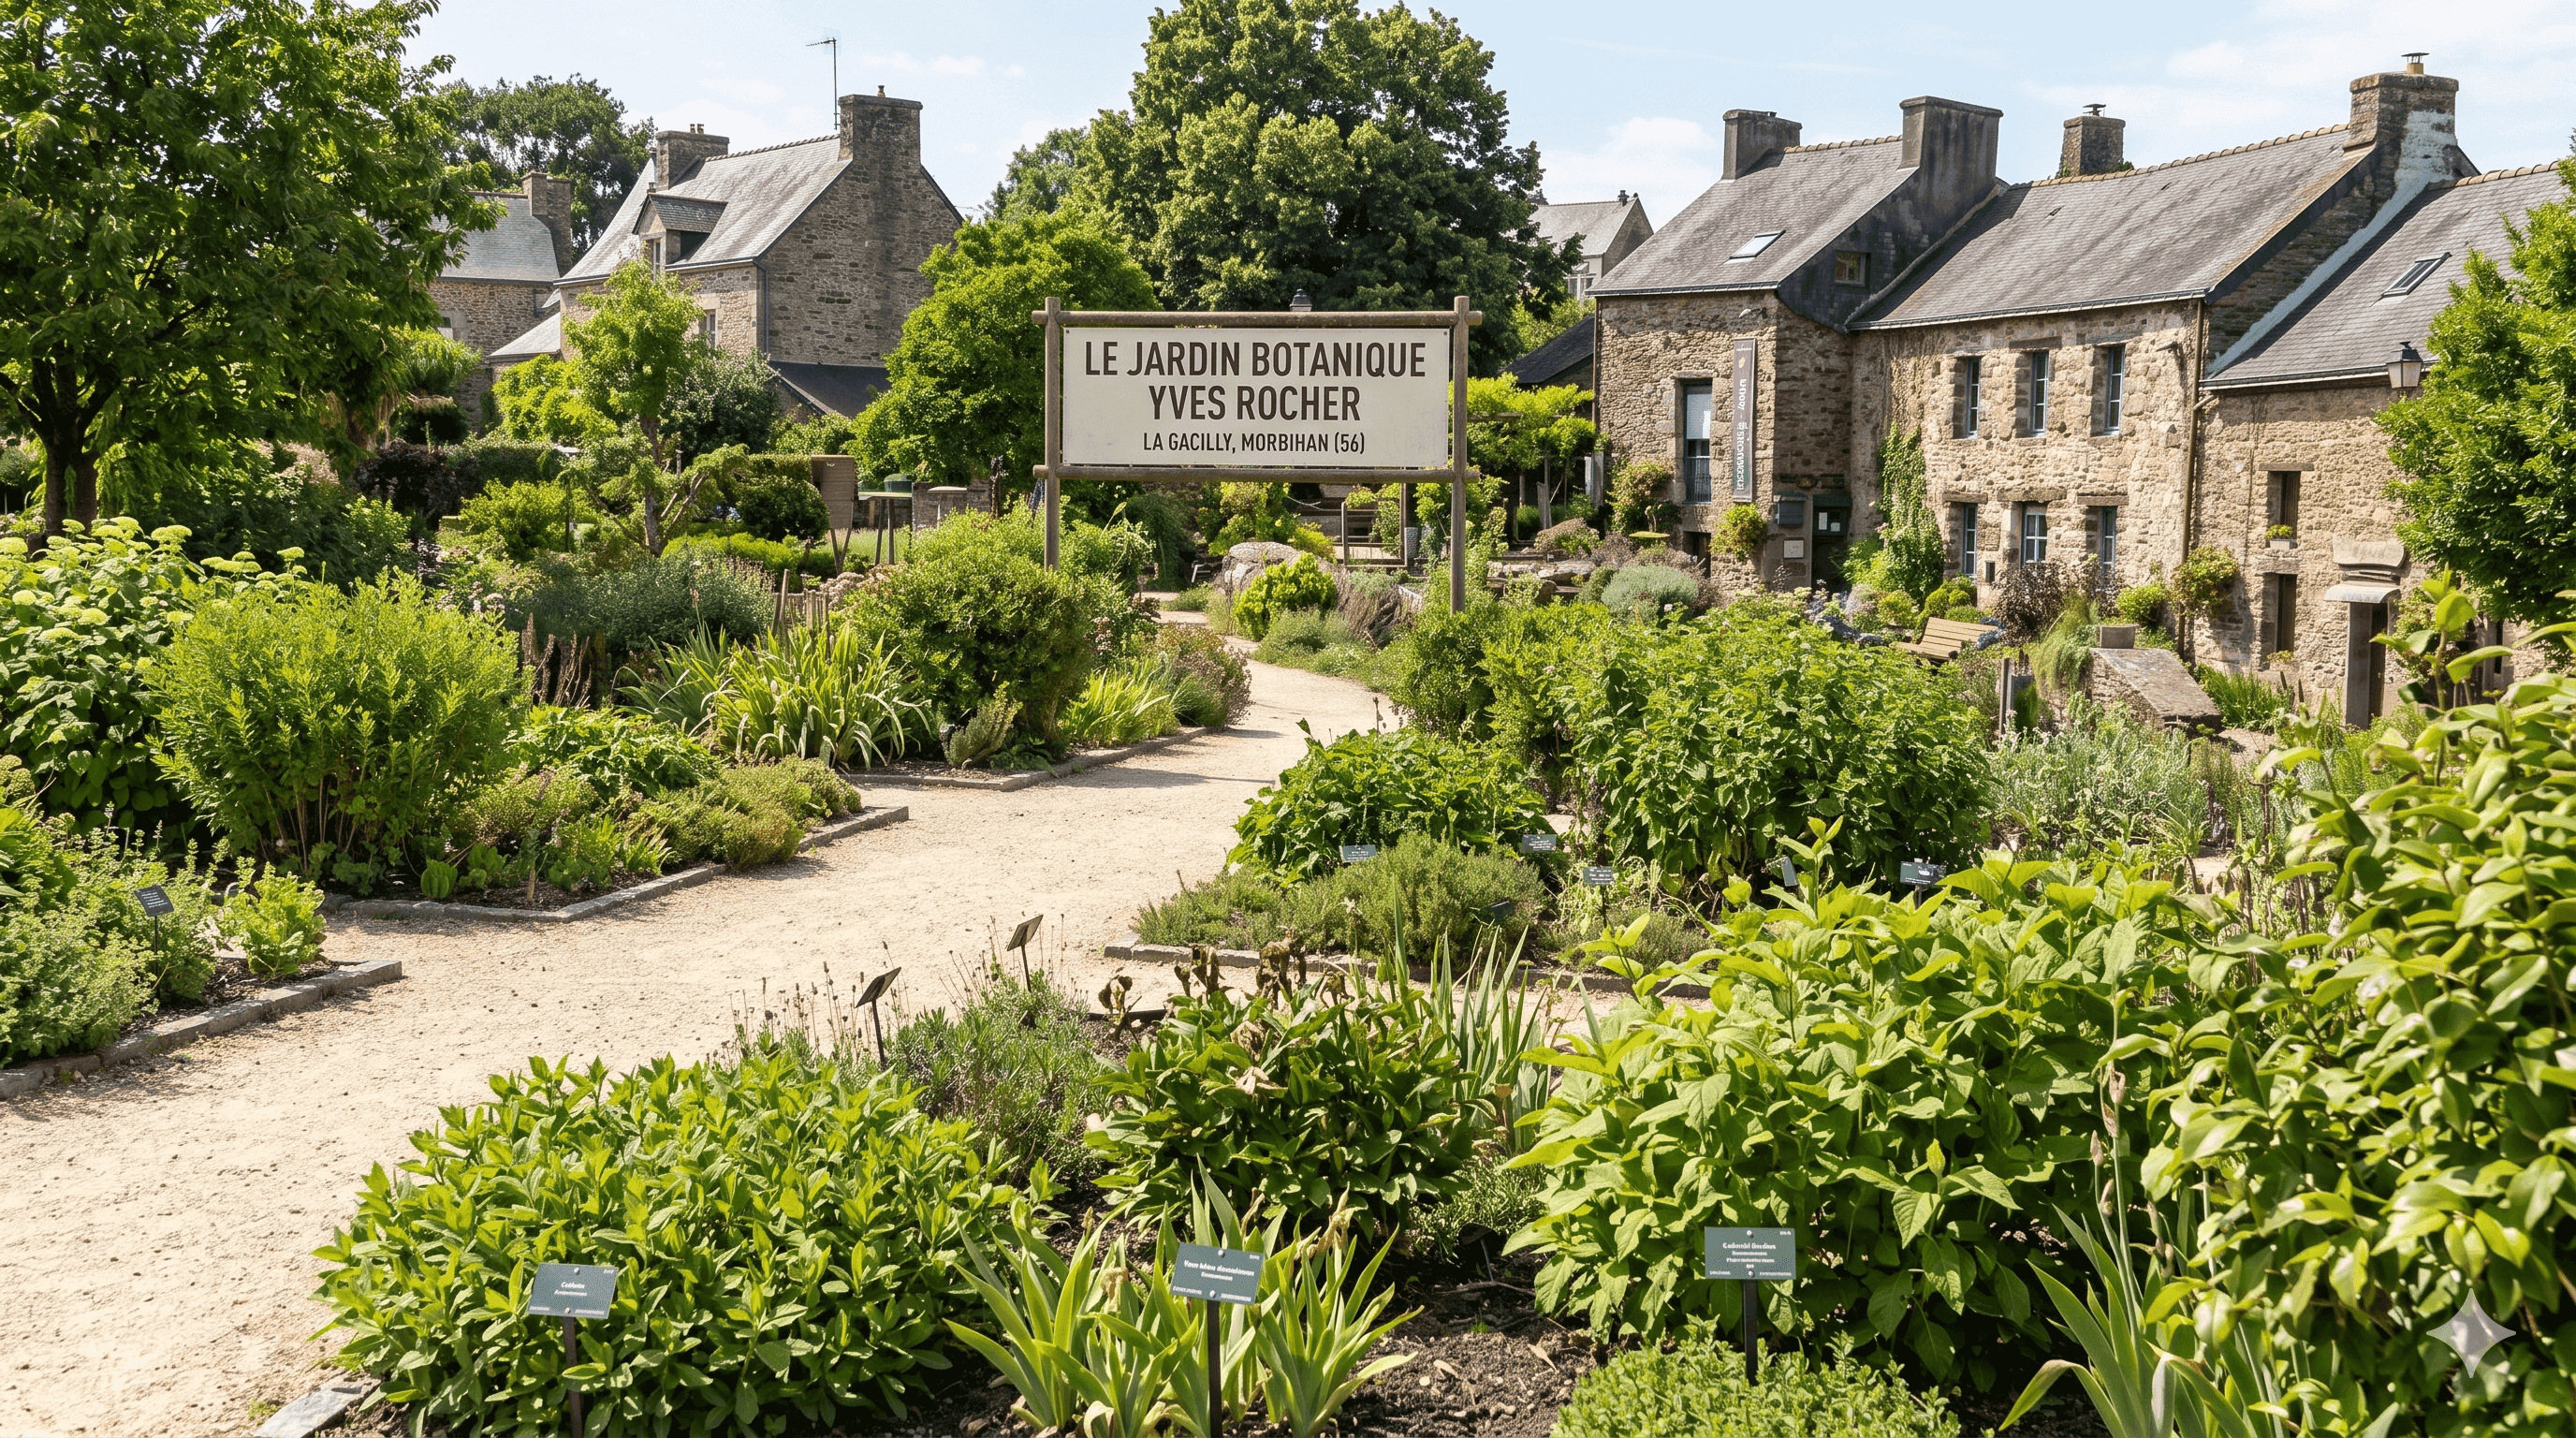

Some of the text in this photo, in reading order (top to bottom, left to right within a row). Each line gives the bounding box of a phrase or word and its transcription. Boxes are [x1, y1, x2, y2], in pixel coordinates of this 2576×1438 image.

[1085, 341, 1427, 378] LE JARDIN BOTANIQUE
[1148, 385, 1361, 421] YVES ROCHER
[1143, 431, 1366, 455] LA GACILLY, MORBIHAN (56)
